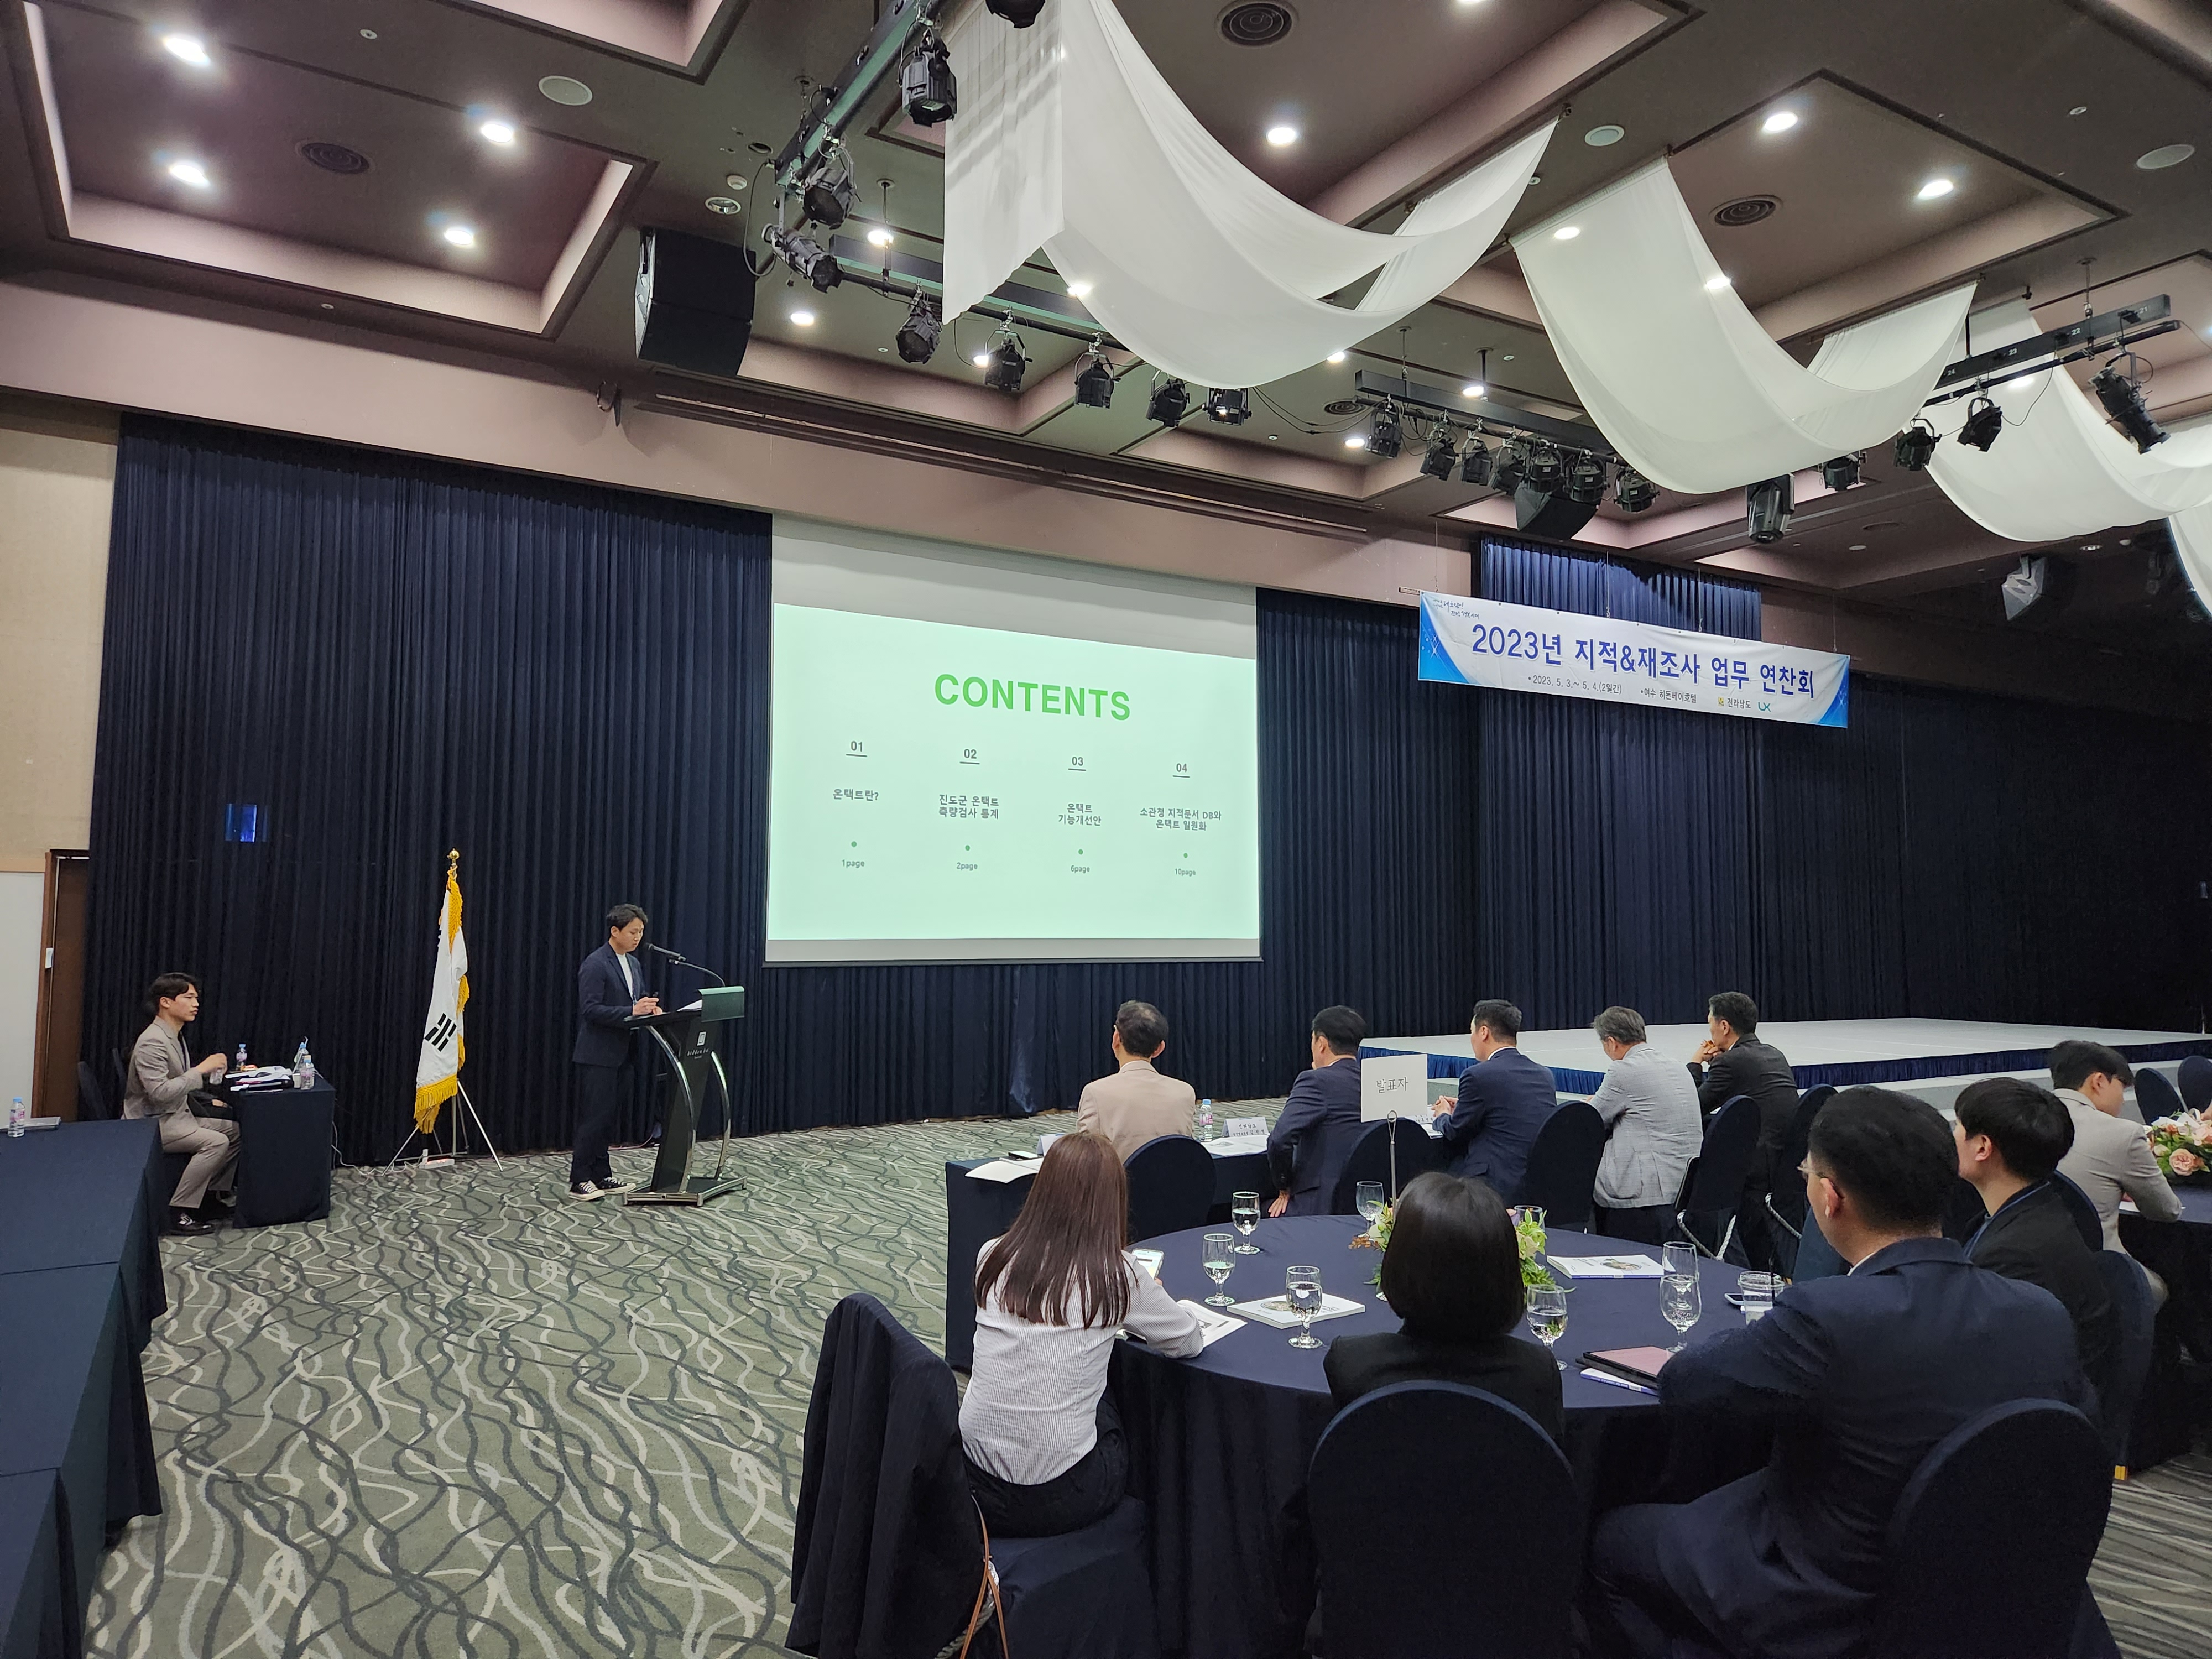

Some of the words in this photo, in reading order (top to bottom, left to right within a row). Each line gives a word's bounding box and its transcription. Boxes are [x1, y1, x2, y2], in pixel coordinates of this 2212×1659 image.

[2072, 327, 2081, 336] 22
[1472, 624, 1562, 665] 2023년
[1575, 639, 1700, 684] 지적&재조사
[1711, 657, 1750, 690] 업무
[1760, 664, 1814, 698] 연찬회
[935, 674, 1130, 721] CONTENTS
[1659, 690, 1697, 703] 히든베이호텔
[1727, 698, 1751, 709] 전라남도
[851, 740, 863, 752] 01
[964, 748, 977, 759] 02
[1071, 756, 1084, 766] 03
[1176, 763, 1187, 773] 04
[832, 789, 879, 801] 온택트란?
[939, 794, 968, 806] 진도군
[971, 796, 999, 807] 온택트
[938, 806, 978, 819] 측량검사
[980, 808, 999, 820] 통계
[1067, 803, 1093, 814] 온택트
[1140, 807, 1165, 818] 소관청
[1168, 808, 1199, 820] 지적문서
[1202, 810, 1222, 821] DB와
[1058, 814, 1102, 826] 기능개선안
[1156, 819, 1180, 830] 온택트
[1183, 820, 1207, 831] 일원화
[842, 859, 865, 869] 1page
[956, 862, 978, 872] 2page
[1071, 865, 1090, 874] 6page
[1175, 868, 1196, 877] 10page
[1376, 1077, 1408, 1093] 발표자
